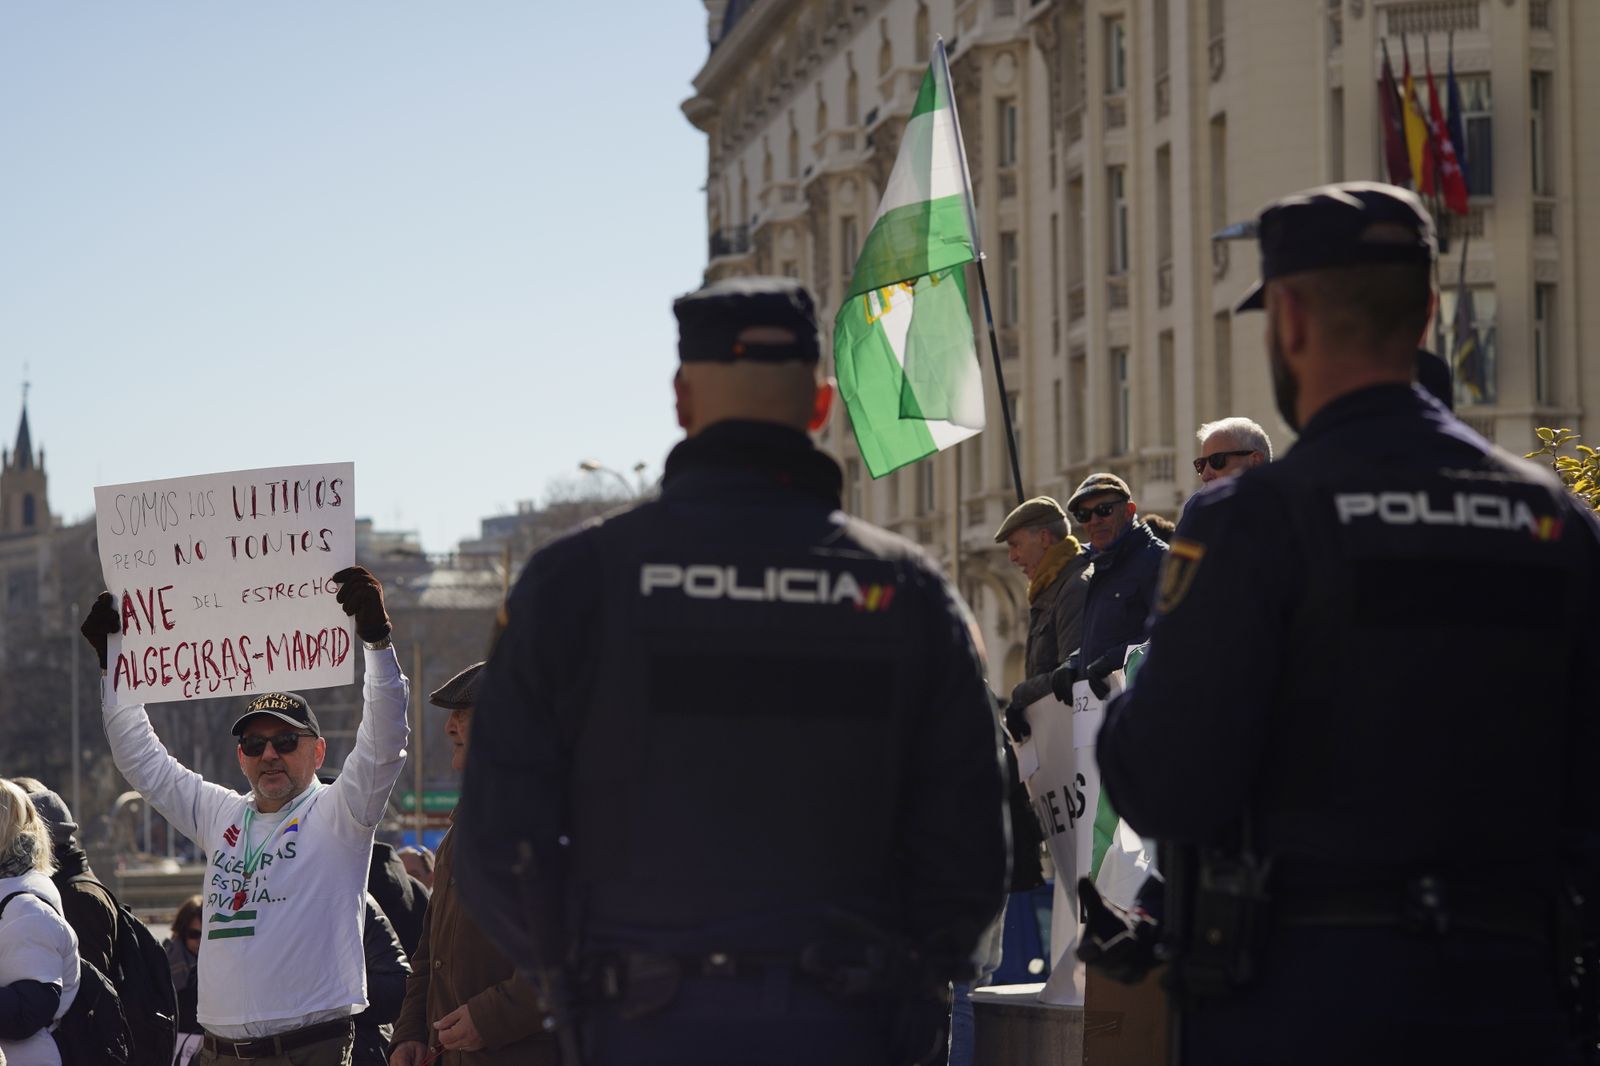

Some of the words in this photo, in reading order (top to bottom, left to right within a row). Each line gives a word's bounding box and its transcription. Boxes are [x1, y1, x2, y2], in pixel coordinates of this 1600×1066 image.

[111, 491, 179, 536] SOMOS
[188, 490, 215, 520] LOS
[232, 476, 343, 521] ULTIMOS
[1335, 491, 1539, 535] POLICIA
[113, 549, 156, 570] PERO
[173, 534, 207, 566] NO
[225, 528, 333, 561] TONTOS
[640, 563, 864, 605] POLICIA
[121, 585, 176, 636] AVE
[192, 593, 223, 610] DEL
[242, 577, 340, 604] ESTRECHO
[184, 672, 256, 698] CEUTA
